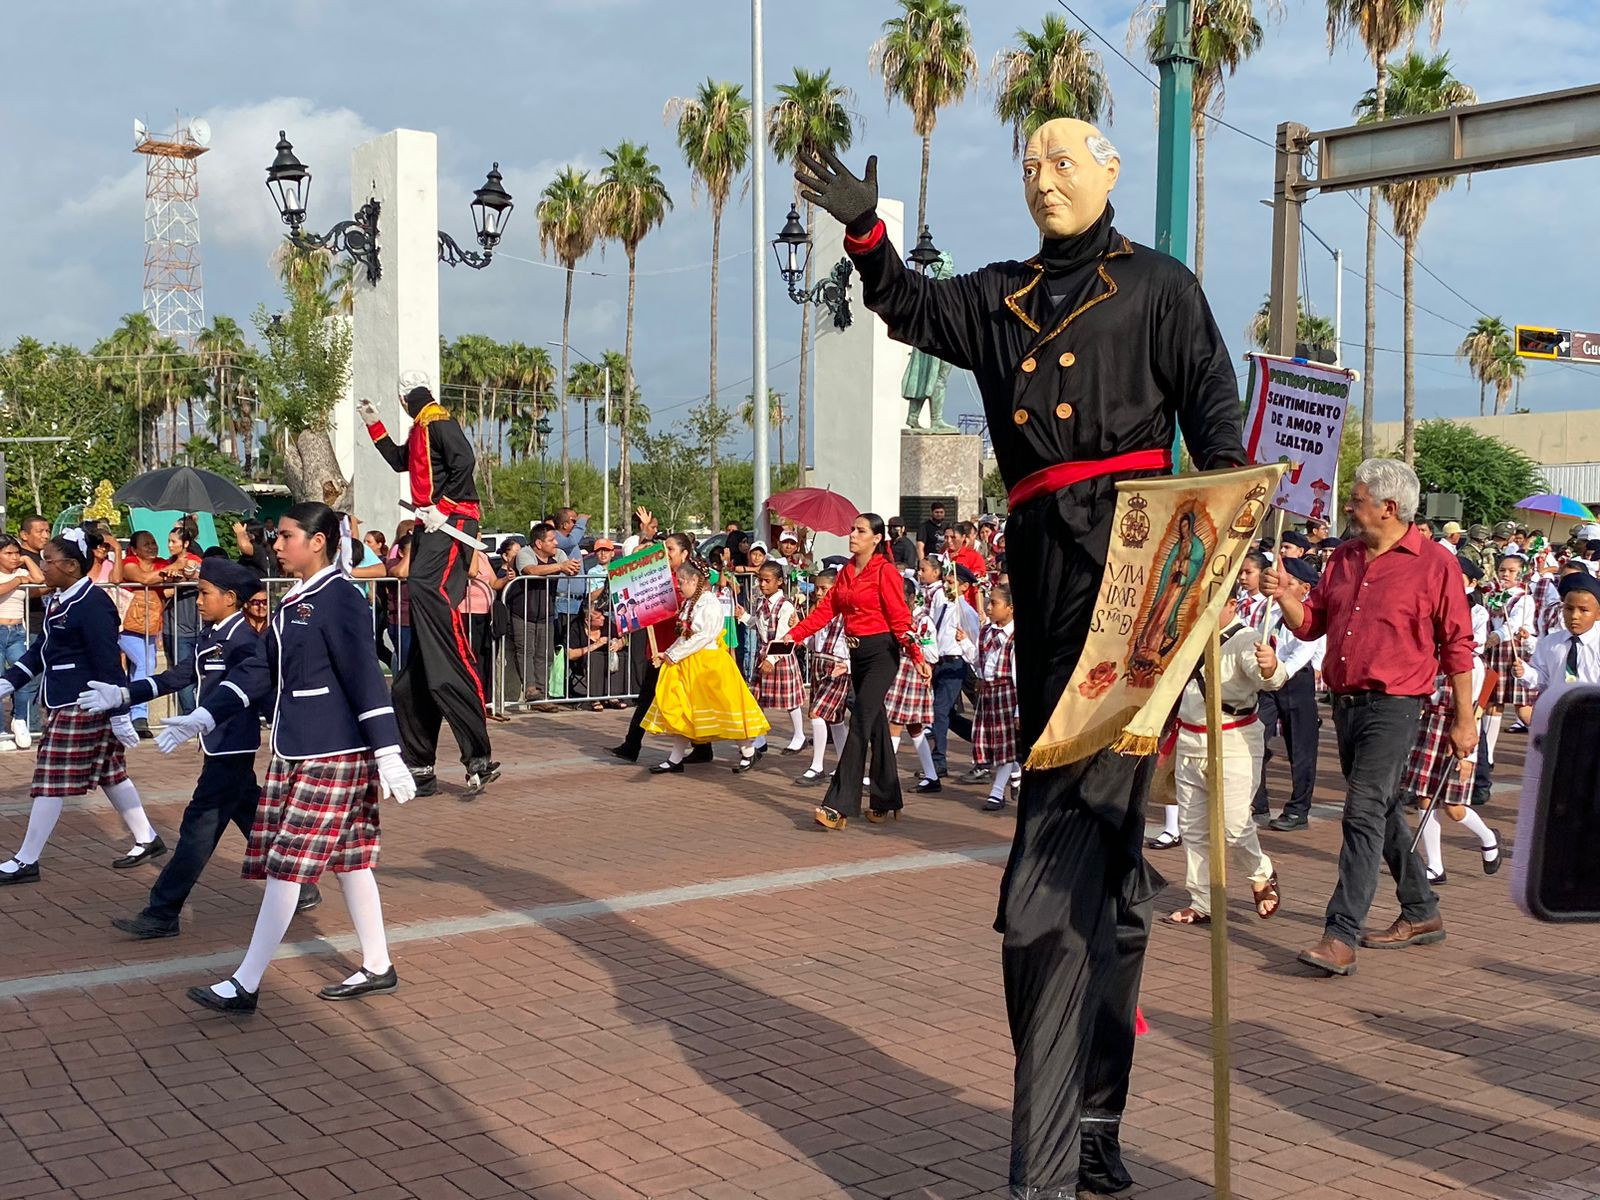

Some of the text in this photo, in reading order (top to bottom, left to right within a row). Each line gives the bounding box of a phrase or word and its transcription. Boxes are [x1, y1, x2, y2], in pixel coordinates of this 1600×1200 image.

[1267, 392, 1341, 420] SENTIMIENTO
[1271, 411, 1336, 439] DE AMOR Y
[1275, 431, 1324, 455] LEALTAD
[644, 569, 657, 577] valor
